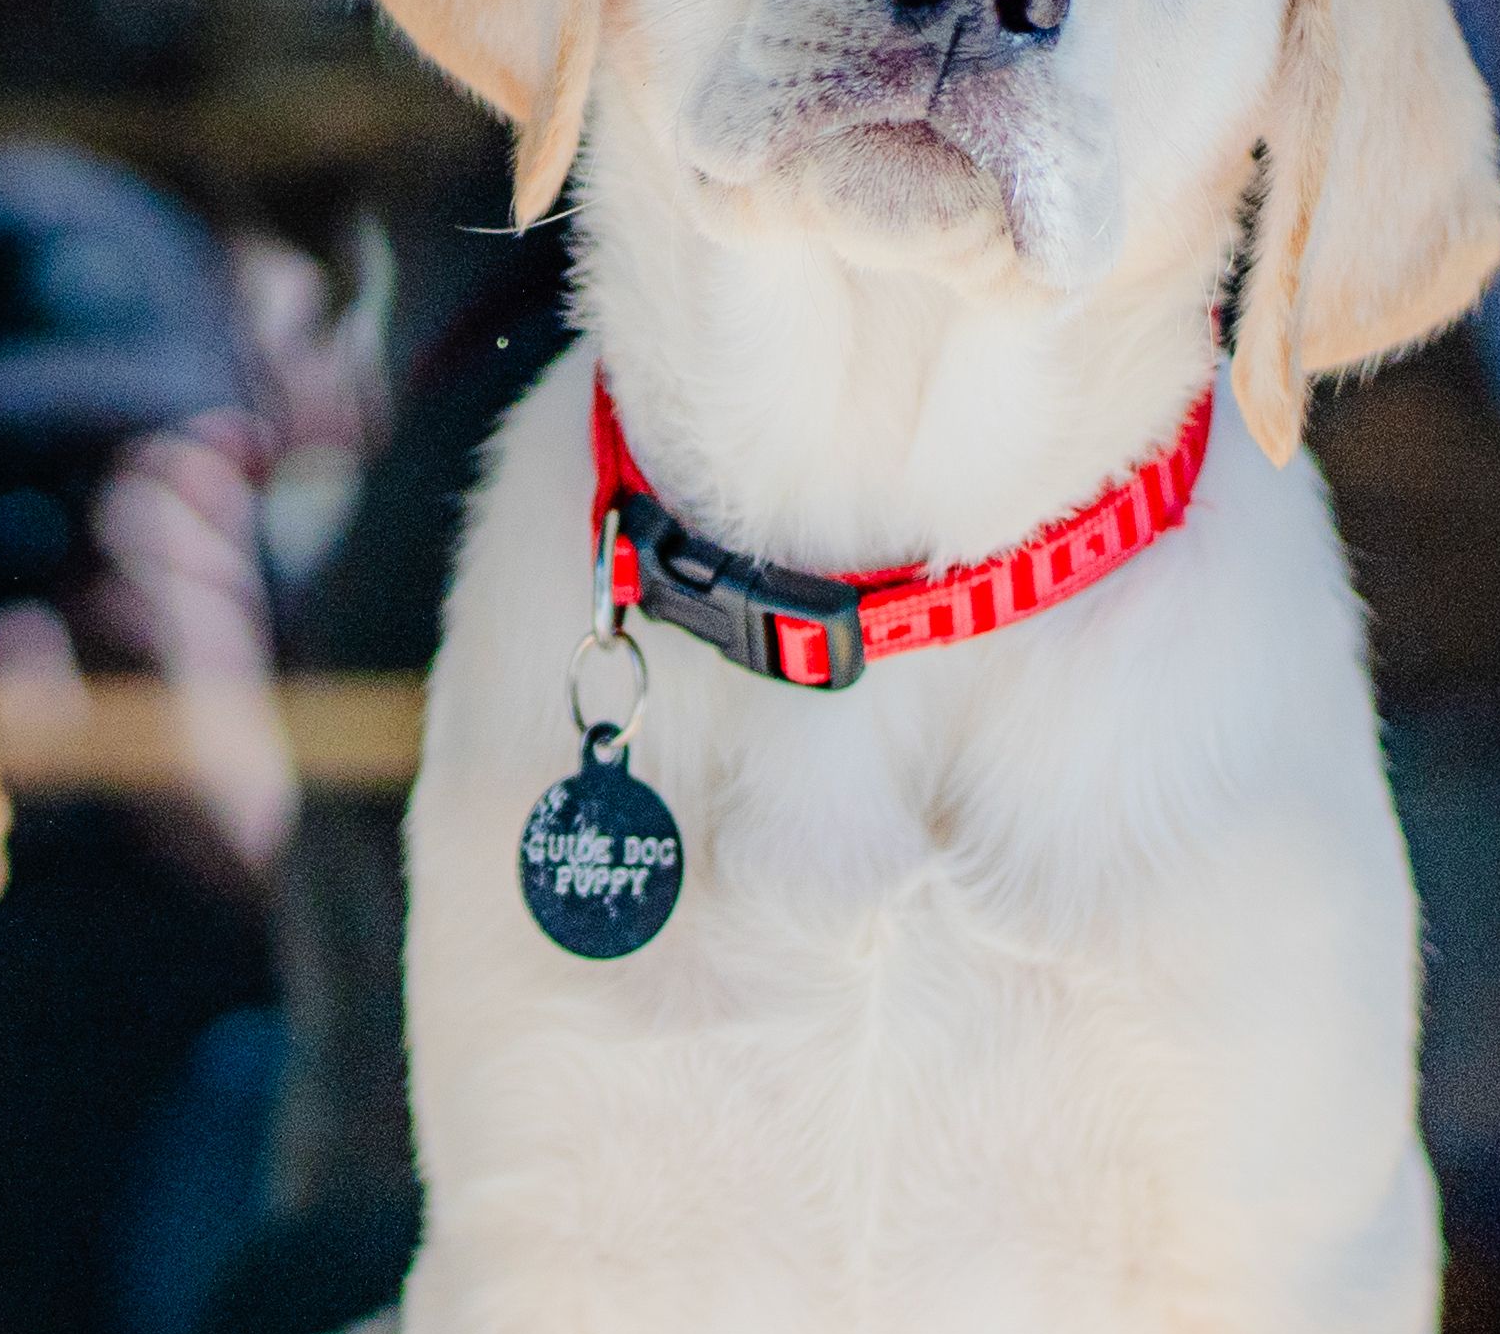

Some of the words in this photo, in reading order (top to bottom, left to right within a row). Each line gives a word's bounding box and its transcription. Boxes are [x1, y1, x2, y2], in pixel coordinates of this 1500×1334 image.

[527, 832, 613, 865] GUIDE
[623, 835, 677, 867] DOG
[555, 865, 650, 898] PUPPY
